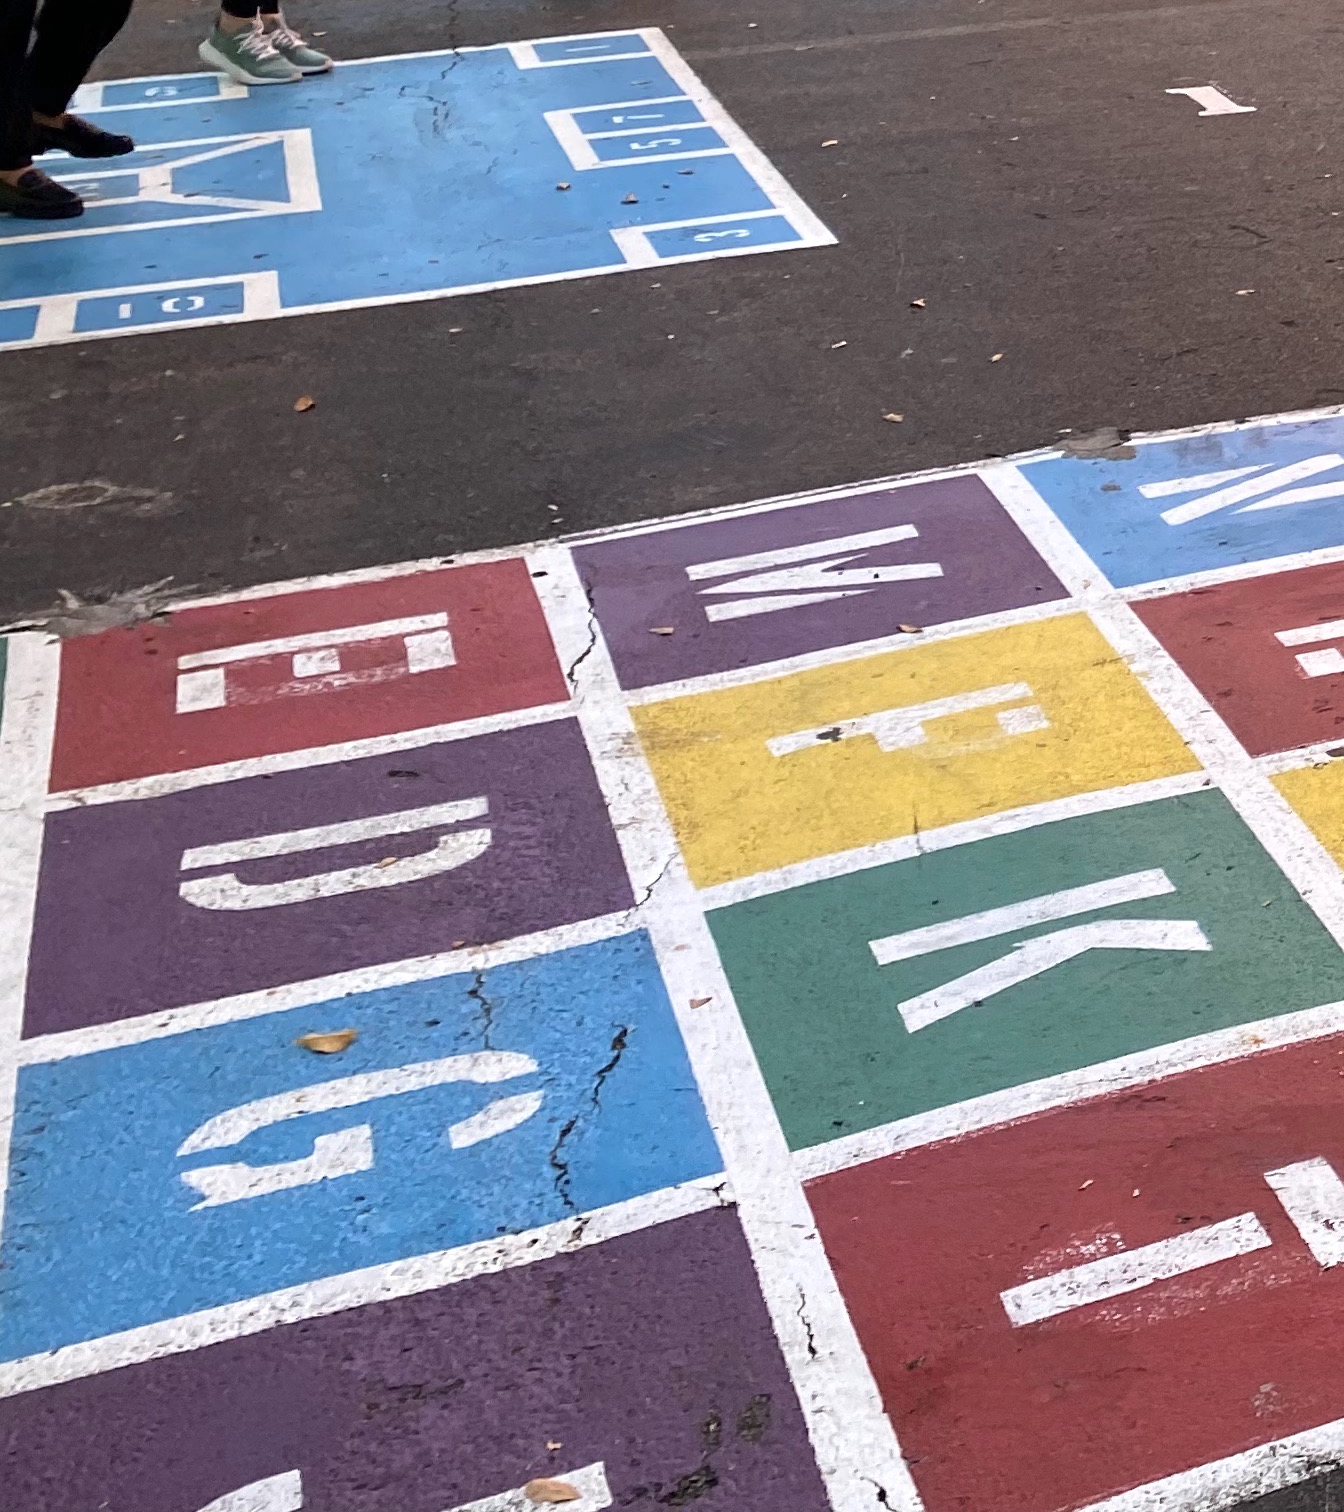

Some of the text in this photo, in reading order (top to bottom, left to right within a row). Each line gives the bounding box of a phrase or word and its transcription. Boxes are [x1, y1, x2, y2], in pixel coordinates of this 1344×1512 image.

[1166, 85, 1258, 117] 1
[685, 523, 945, 623] M
[176, 612, 458, 714] E
[766, 682, 1050, 756] F
[178, 795, 493, 912] D
[868, 867, 1214, 1034] K
